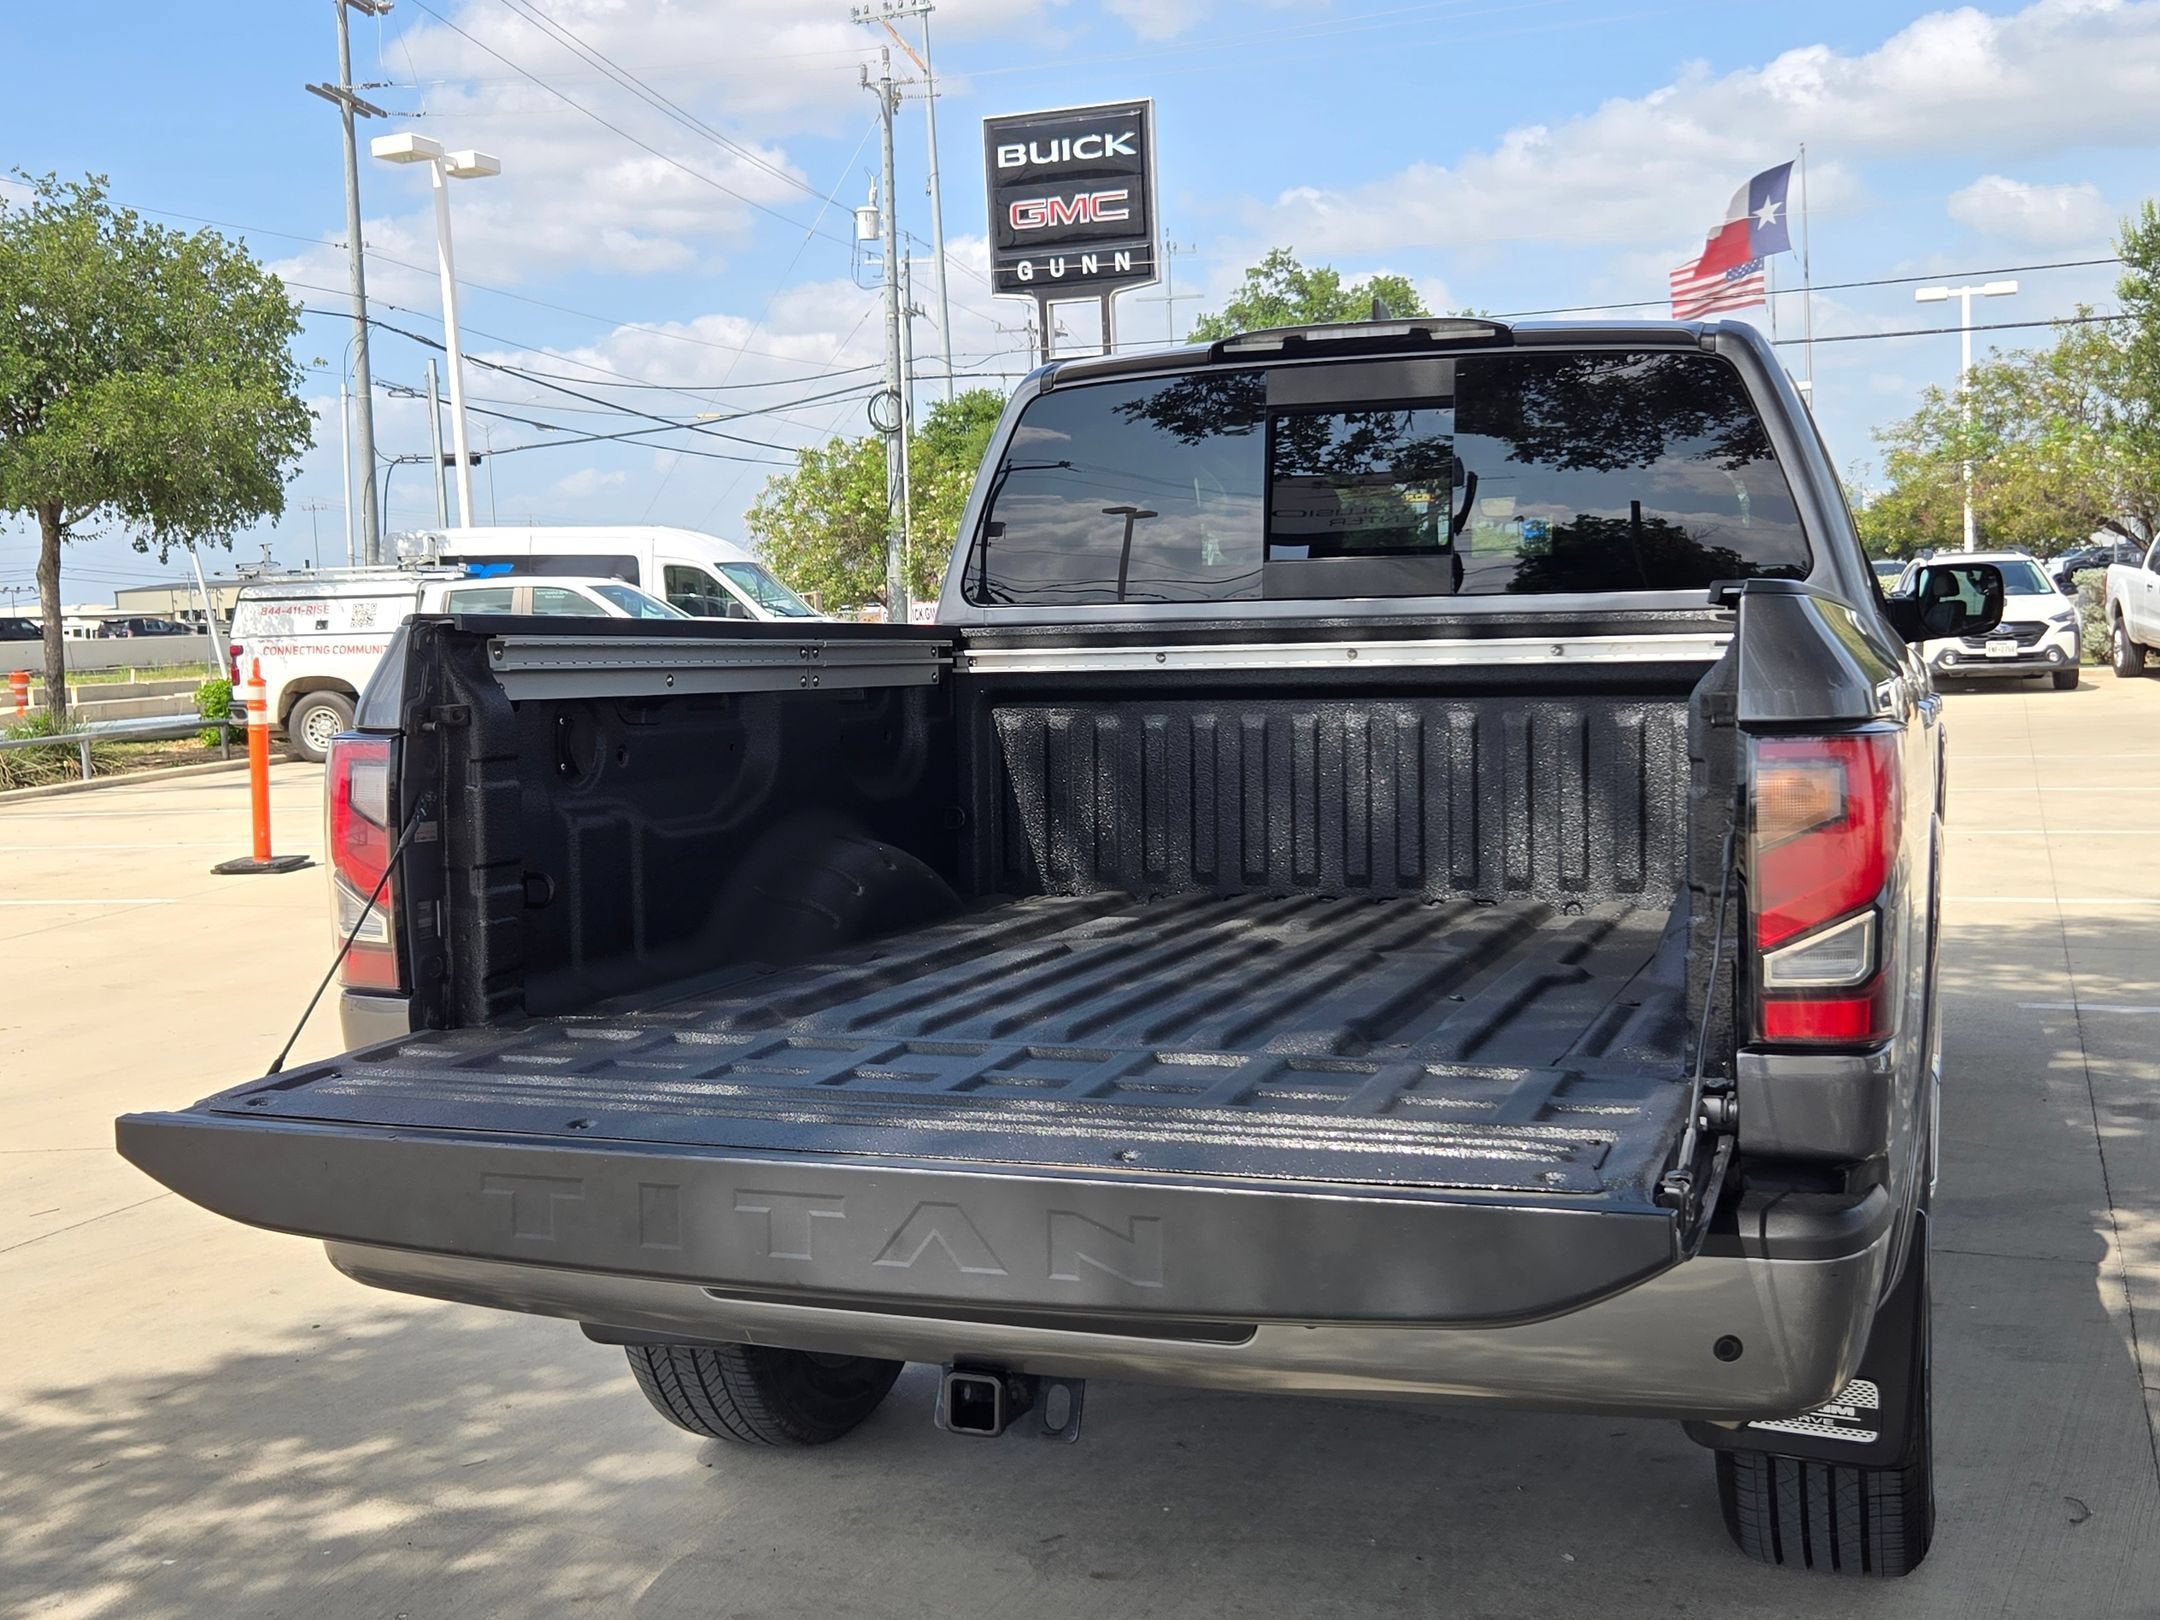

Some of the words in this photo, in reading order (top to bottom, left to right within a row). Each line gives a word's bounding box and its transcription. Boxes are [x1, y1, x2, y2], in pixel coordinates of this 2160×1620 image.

[997, 131, 1137, 168] BUICK
[1009, 189, 1129, 230] GMC
[1017, 251, 1131, 281] GUNN
[260, 604, 330, 616] 844-411-RISE
[263, 645, 331, 656] CONNECTING
[480, 1171, 1164, 1287] TITAN
